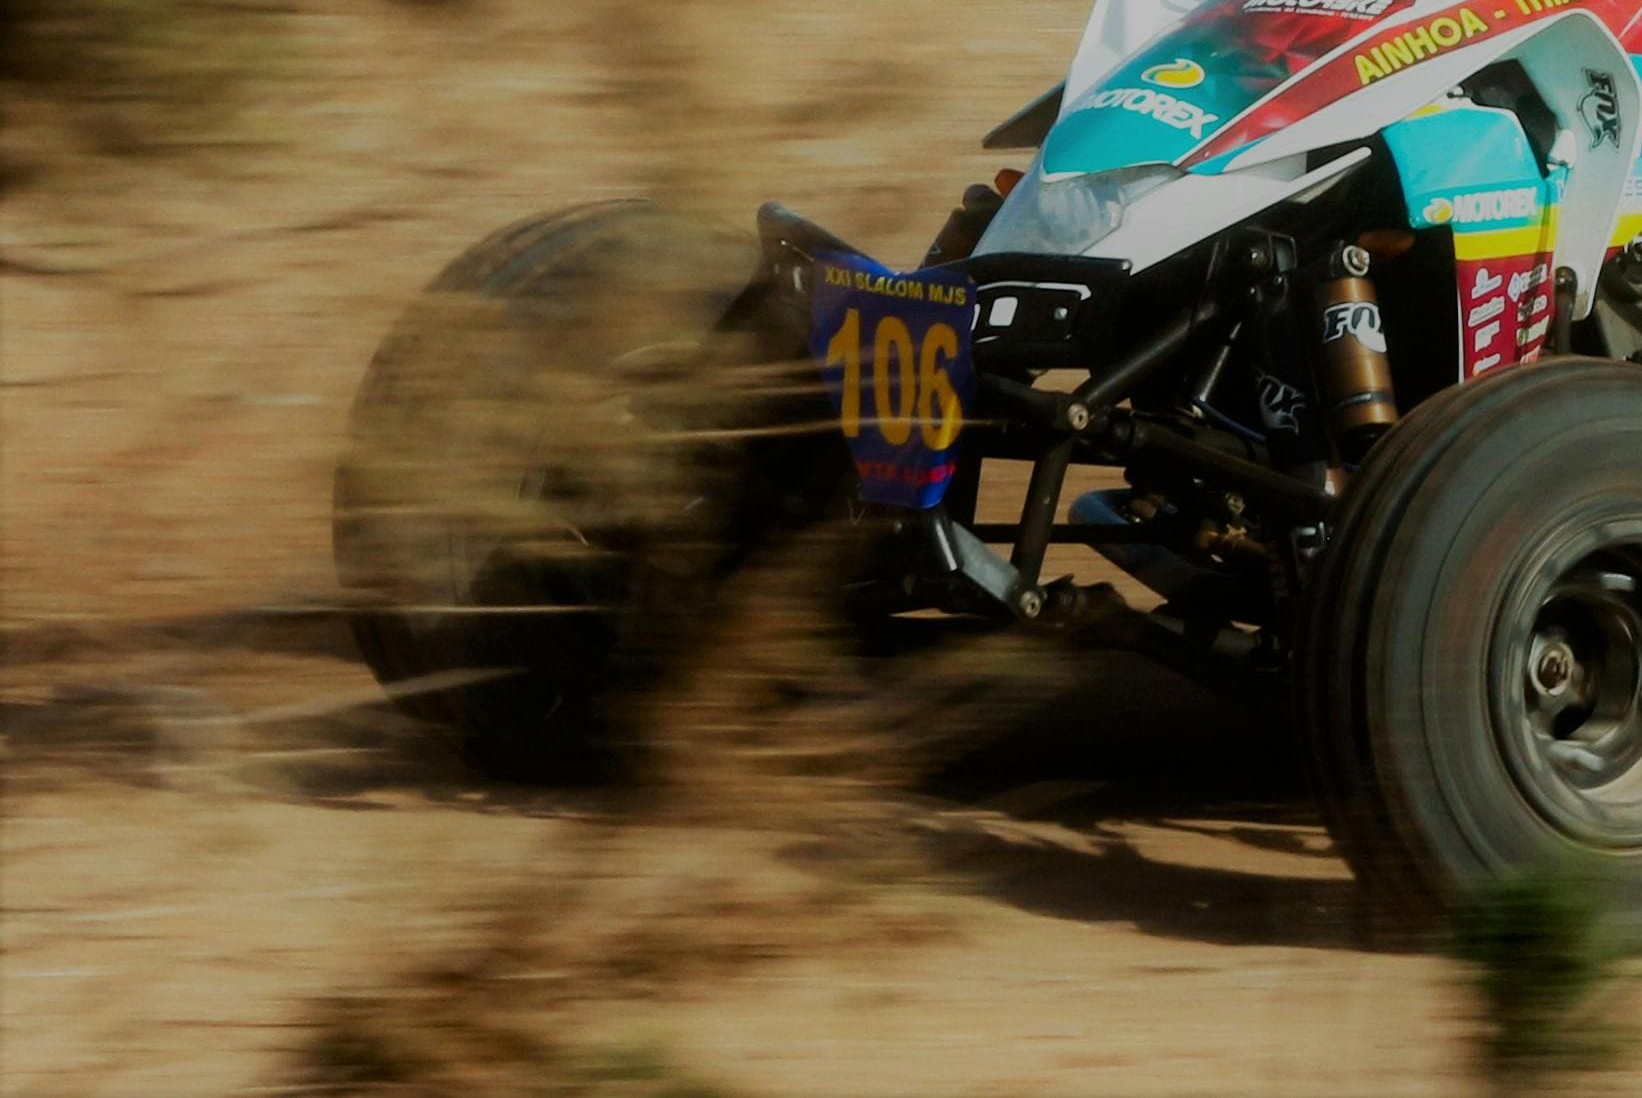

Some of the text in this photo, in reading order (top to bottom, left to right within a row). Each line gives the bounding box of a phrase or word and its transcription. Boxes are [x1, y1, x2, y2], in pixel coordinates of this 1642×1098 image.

[1353, 7, 1489, 85] AINHOA
[1453, 187, 1537, 223] MOTOREX
[855, 272, 923, 300] SLALOM
[928, 284, 967, 306] MJS
[1324, 304, 1376, 343] FO
[827, 307, 963, 451] 106
